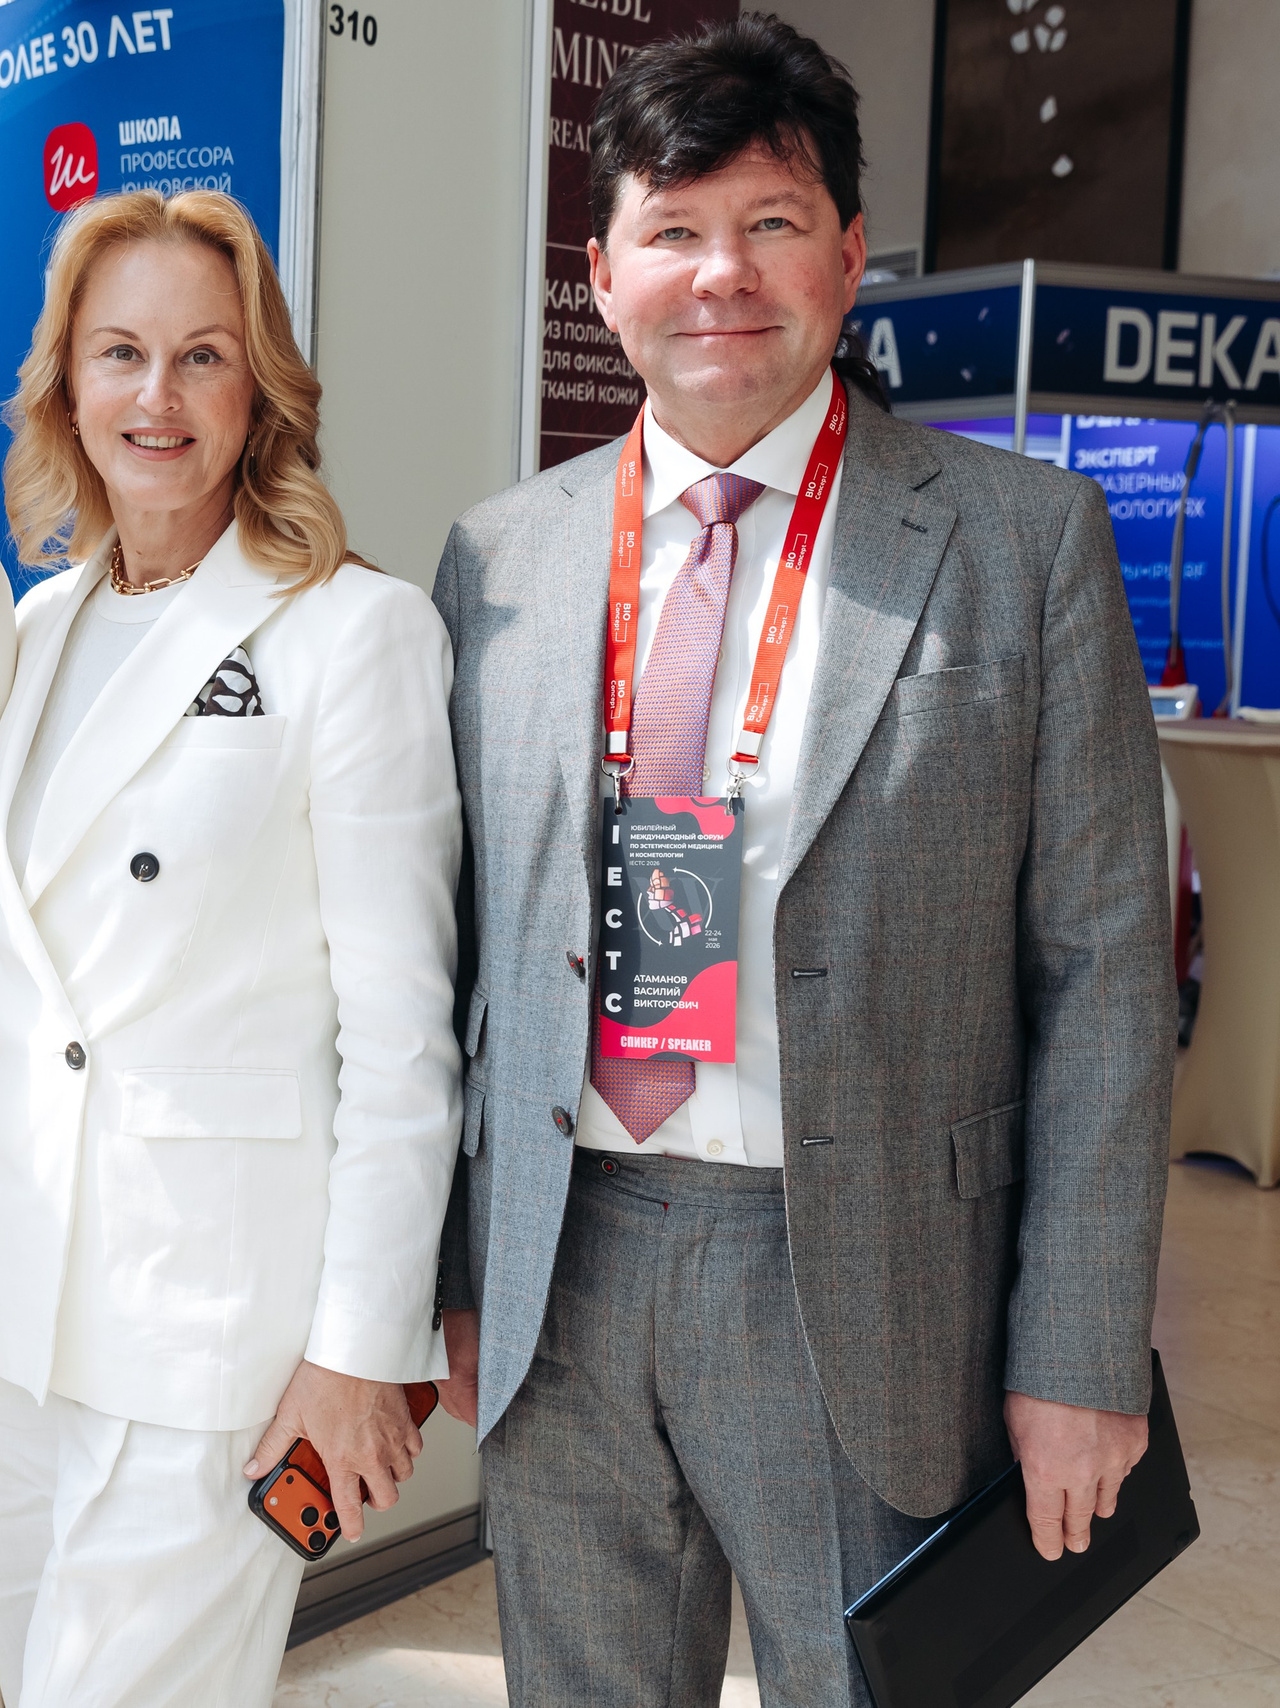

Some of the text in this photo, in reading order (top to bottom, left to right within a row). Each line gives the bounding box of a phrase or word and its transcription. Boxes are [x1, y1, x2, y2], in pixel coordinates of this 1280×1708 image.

[329, 5, 378, 47] 310
[61, 21, 99, 67] 30
[108, 8, 174, 58] ЛЕТ
[119, 115, 182, 146] ШКОЛА
[121, 146, 235, 174] ПРОФЕССОРА
[1103, 305, 1280, 391] DEKA
[542, 350, 639, 380] ДЛЯ ФИКСАЦ
[541, 380, 638, 406] ТКАНЕЙ КОЖИ
[829, 413, 839, 431] BIO
[628, 460, 636, 478] BIO
[805, 481, 817, 498] BIO
[814, 475, 827, 500] Concept
[626, 531, 635, 548] BIO
[785, 552, 797, 569] BIO
[795, 544, 807, 571] Concept
[622, 603, 632, 621] BIO
[766, 625, 777, 644] BIO
[776, 617, 788, 645] Concept
[609, 680, 617, 709] Concept
[617, 680, 626, 698] BIO
[746, 705, 759, 722] BIO
[756, 694, 769, 723] Concept
[630, 833, 724, 841] МЕЖДУНАРОДНЫЙ ФОРУМ
[704, 929, 722, 937] 22-24
[633, 974, 688, 984] АТАМАНОВ
[633, 986, 681, 997] ВАСИЛИЙ
[633, 999, 699, 1010] ВИКТОРОВИЧ
[620, 1035, 659, 1049] СПИКЕР
[667, 1038, 712, 1052] SPEAKER
